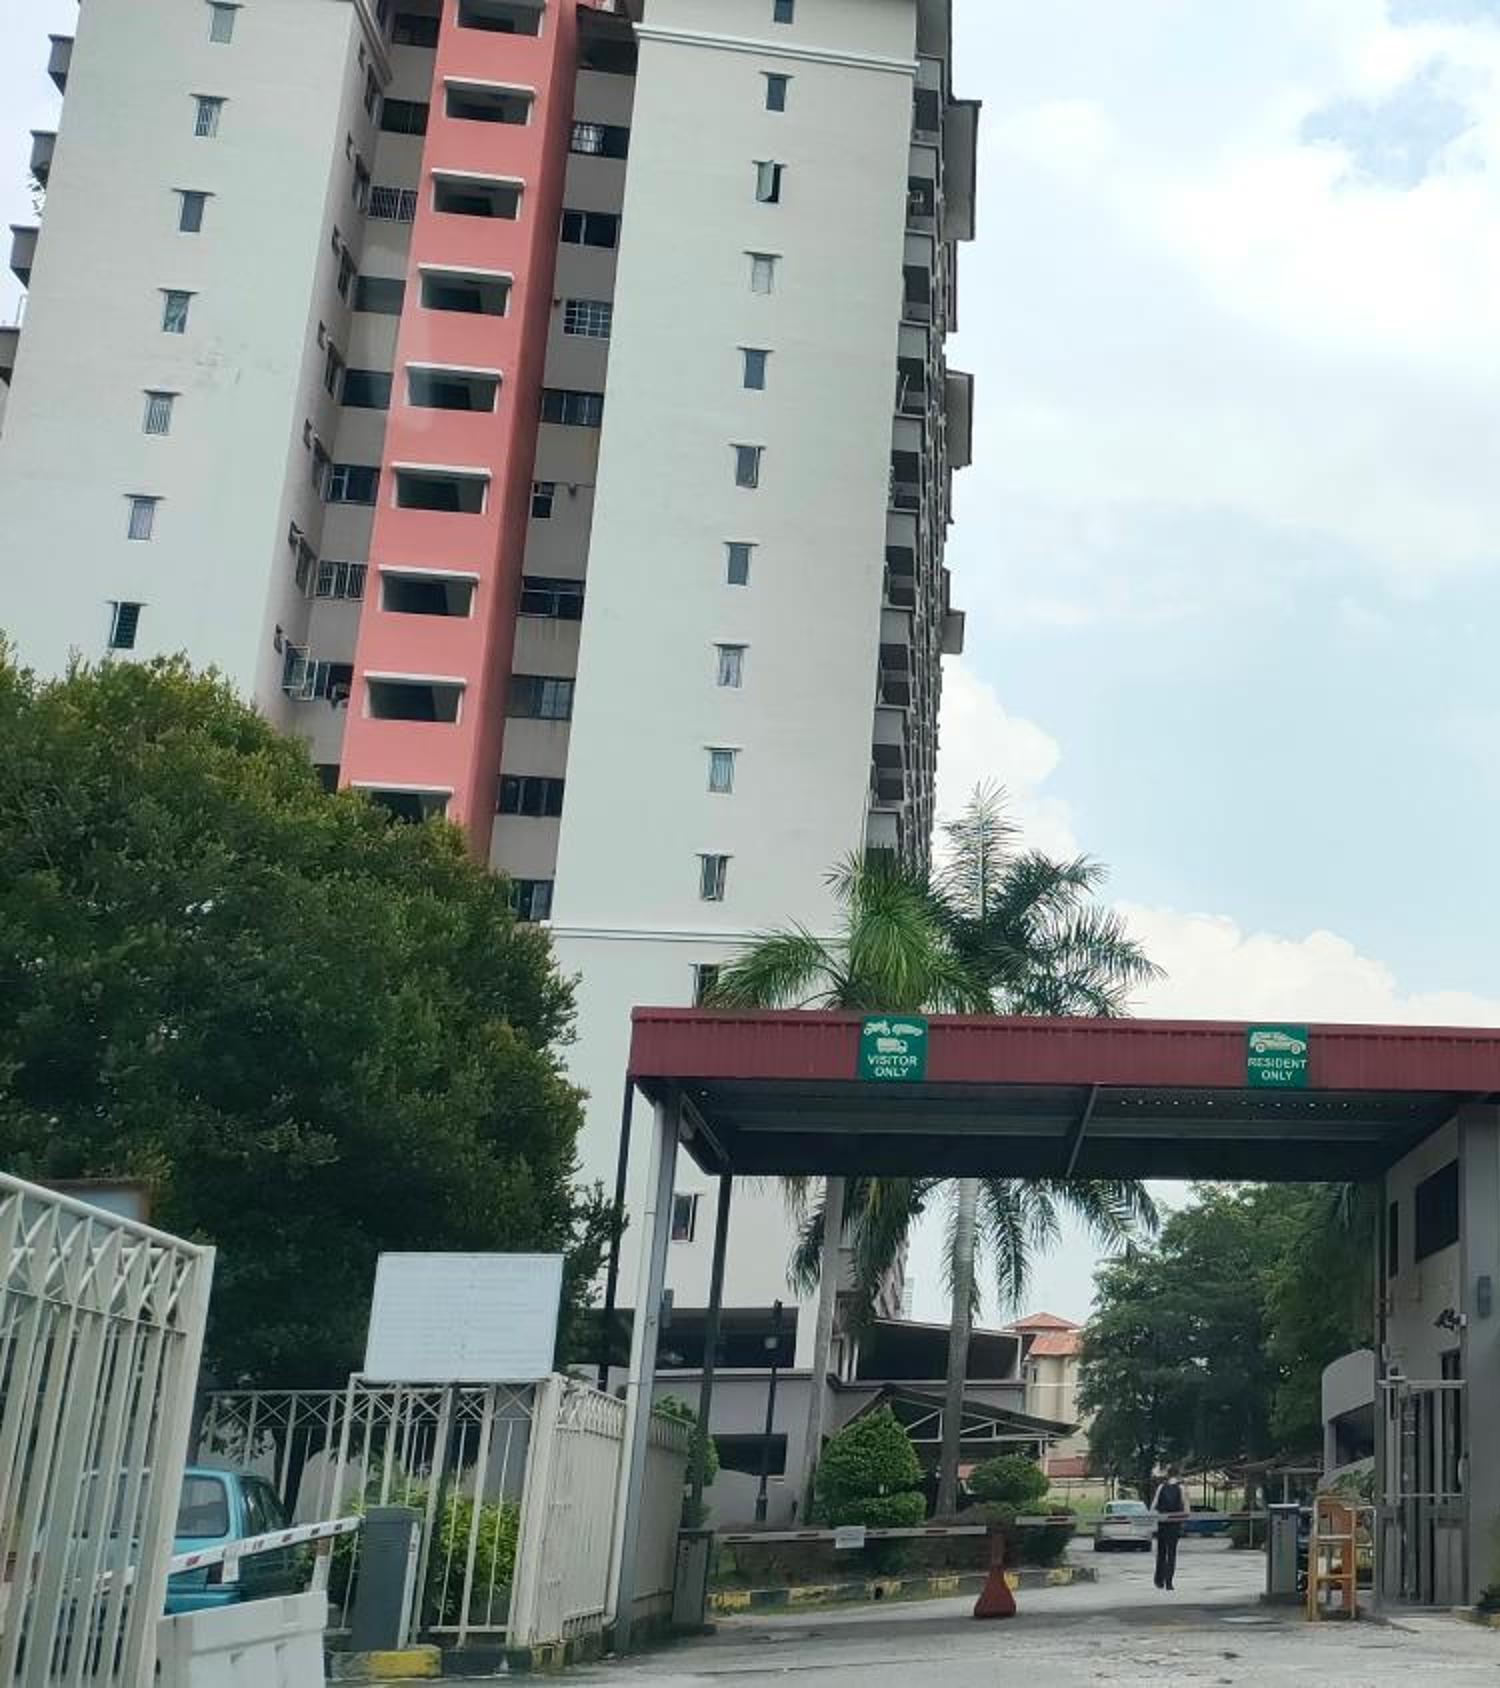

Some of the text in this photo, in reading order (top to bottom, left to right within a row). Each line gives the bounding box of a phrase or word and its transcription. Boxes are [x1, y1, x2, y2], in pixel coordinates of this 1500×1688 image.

[867, 1054, 918, 1067] VISITOR
[1247, 1057, 1307, 1069] RESIDENT
[874, 1066, 909, 1078] ONLY
[1261, 1069, 1293, 1081] ONLY
